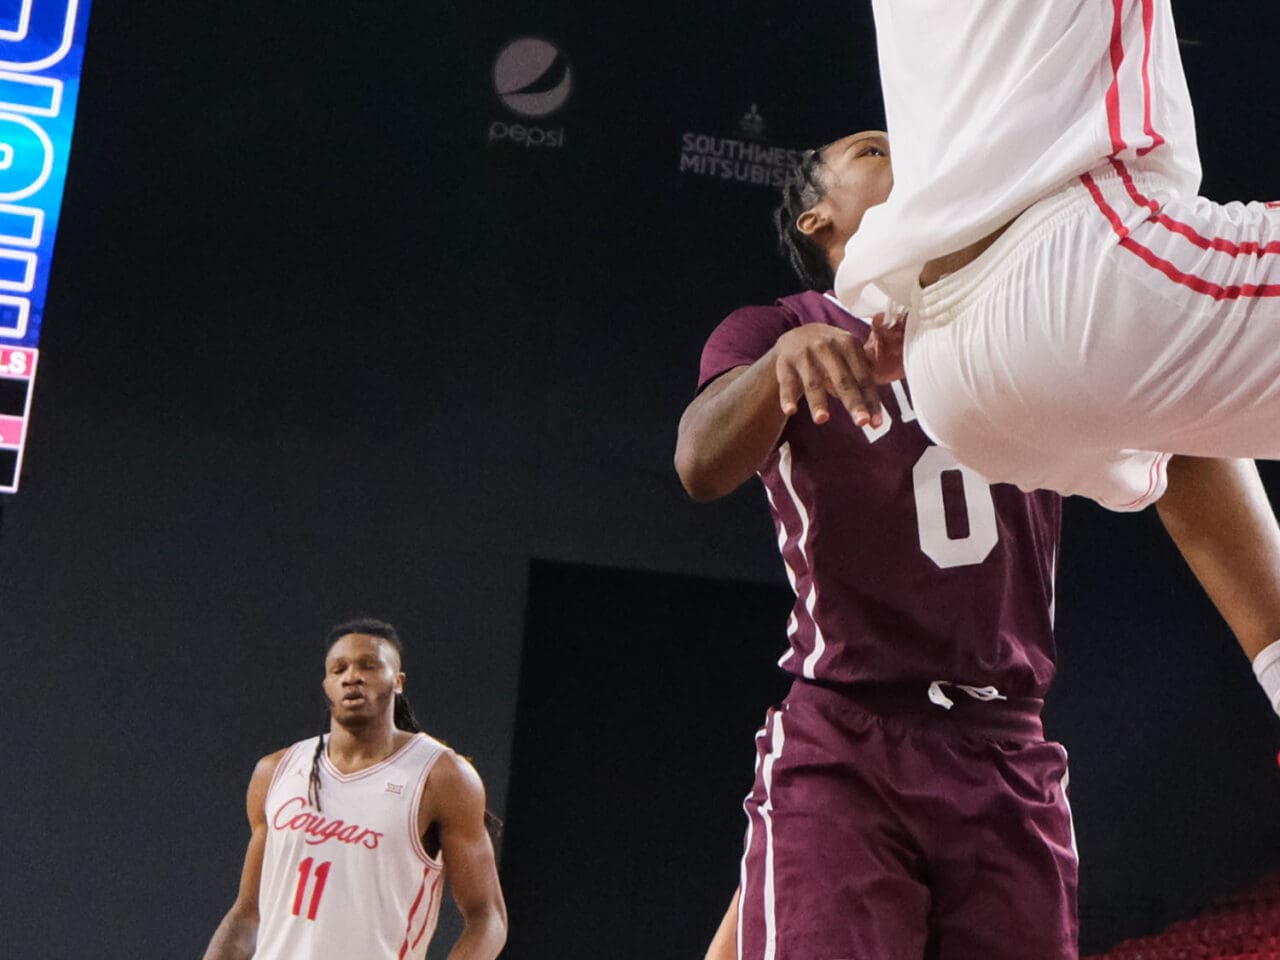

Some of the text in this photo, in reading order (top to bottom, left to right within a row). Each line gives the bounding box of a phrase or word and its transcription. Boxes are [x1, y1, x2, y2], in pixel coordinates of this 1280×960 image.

[489, 121, 564, 148] pepsi
[682, 132, 800, 167] SOUTHWES
[912, 445, 999, 569] 0
[273, 797, 384, 849] Cougars
[292, 856, 332, 921] 11
